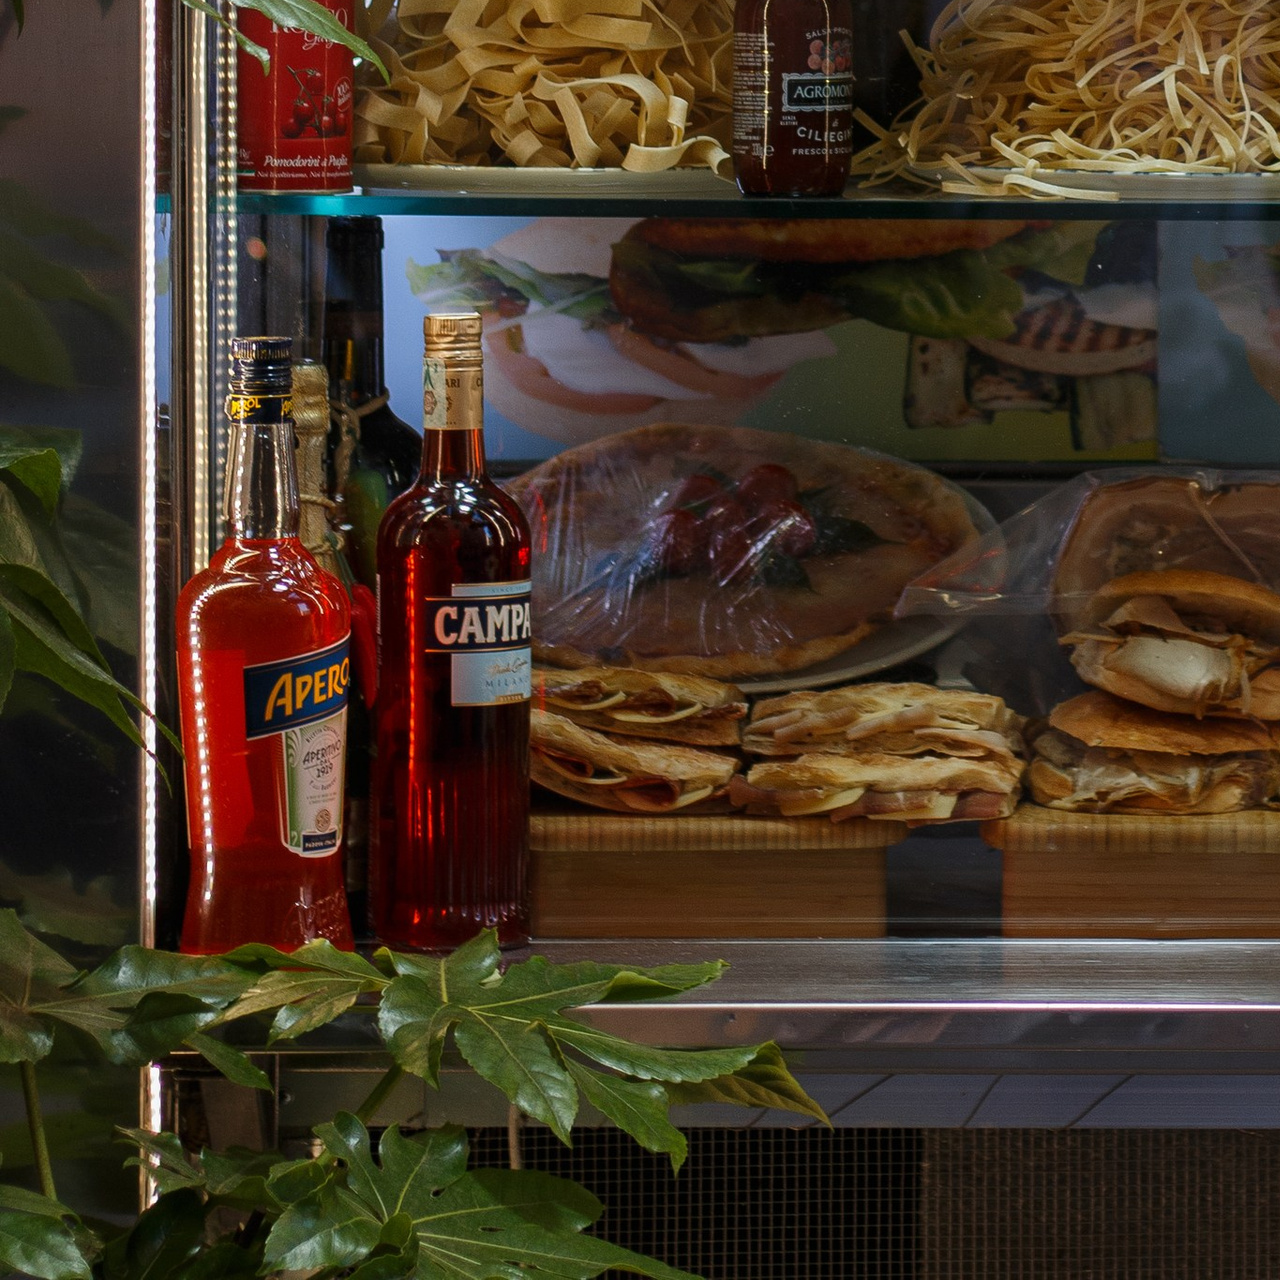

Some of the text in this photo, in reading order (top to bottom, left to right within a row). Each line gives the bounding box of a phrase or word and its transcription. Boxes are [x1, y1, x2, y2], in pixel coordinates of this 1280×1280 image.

[805, 28, 831, 40] SALSA
[792, 147, 828, 156] FRESCO
[262, 154, 321, 168] Pomodorini
[302, 739, 342, 765] APERITIVO
[315, 762, 334, 779] 1919
